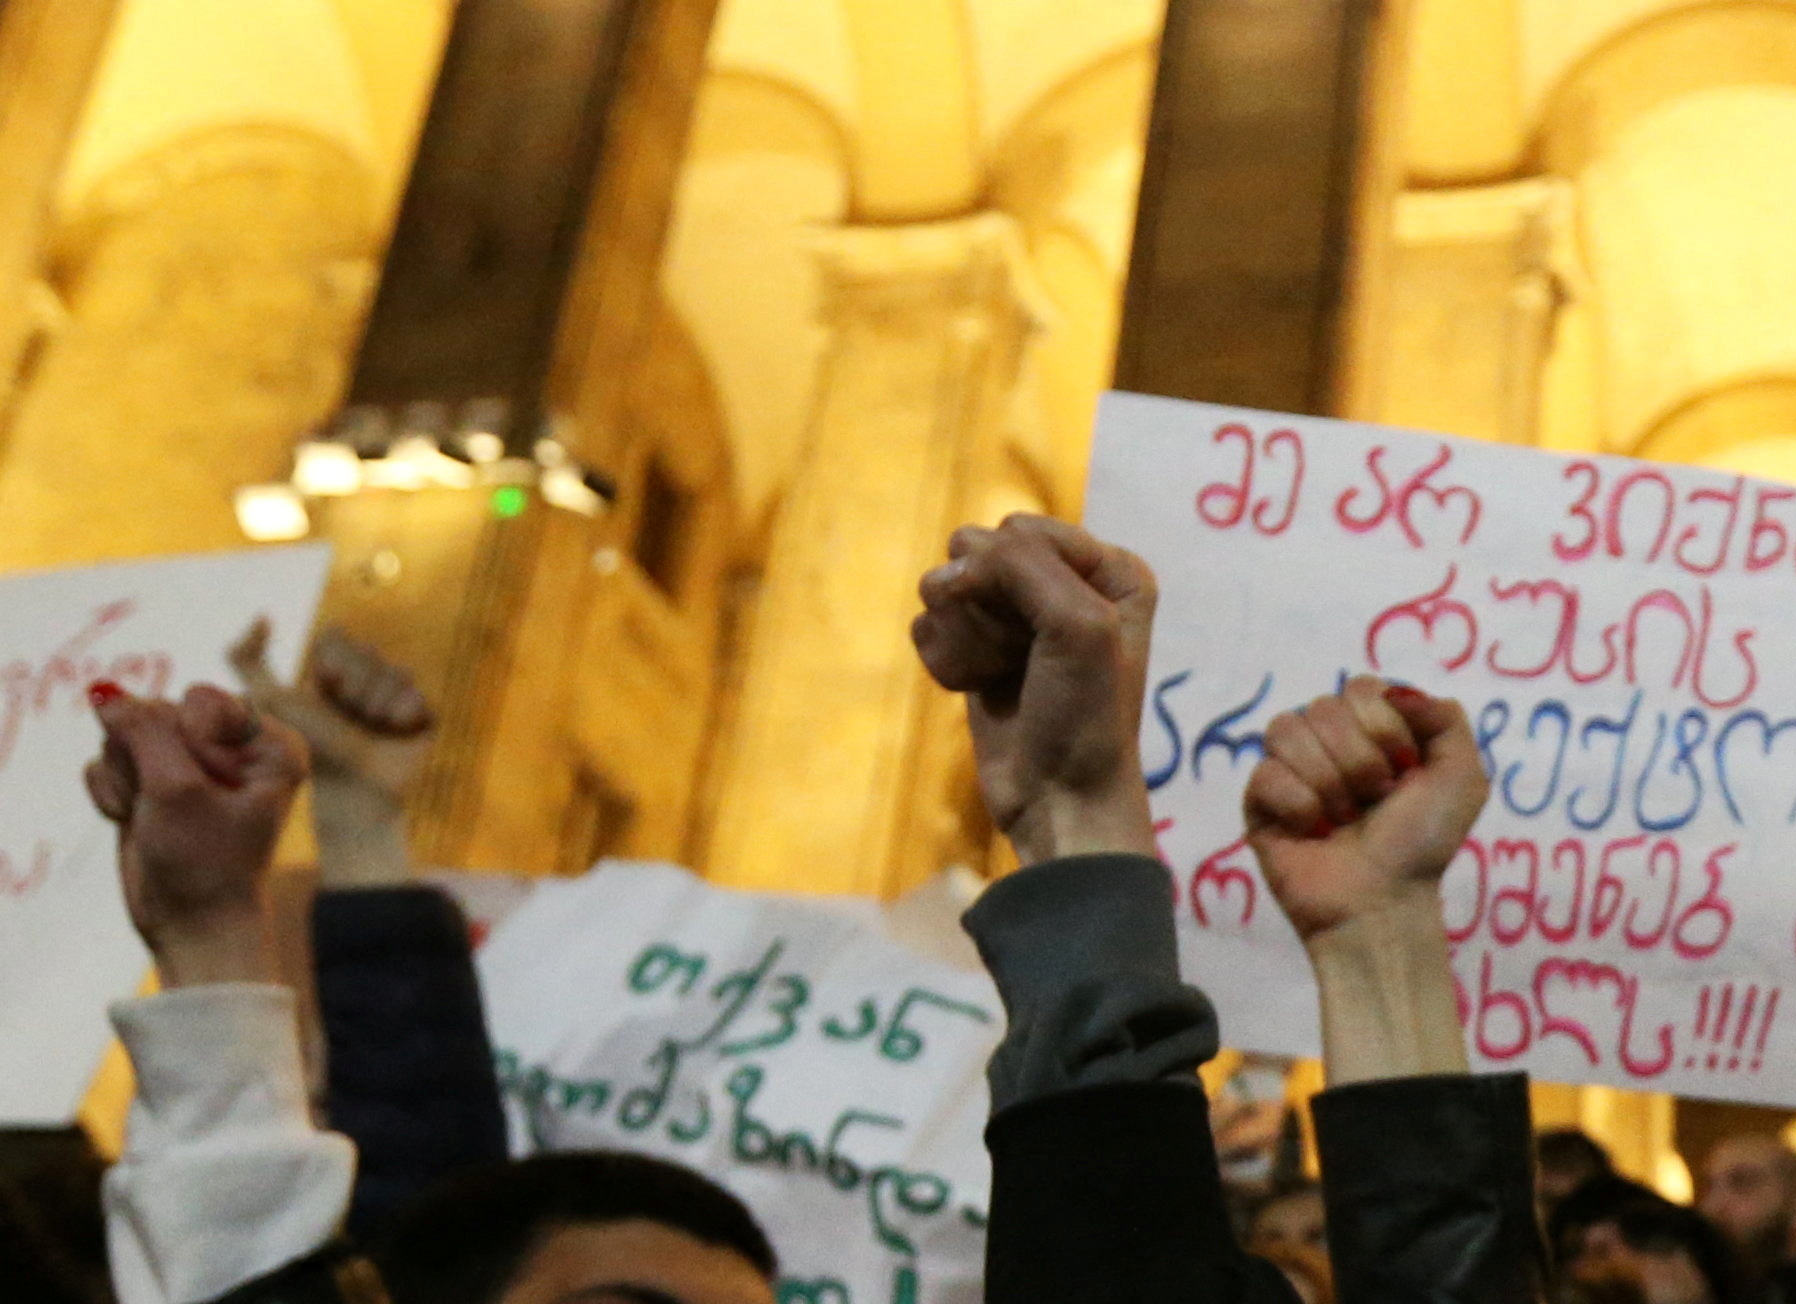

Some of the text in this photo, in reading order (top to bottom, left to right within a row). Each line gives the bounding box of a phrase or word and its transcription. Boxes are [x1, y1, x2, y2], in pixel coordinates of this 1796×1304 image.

[1197, 423, 1304, 537] მე
[1335, 443, 1482, 548] არ
[1366, 562, 1758, 710] რუსის
